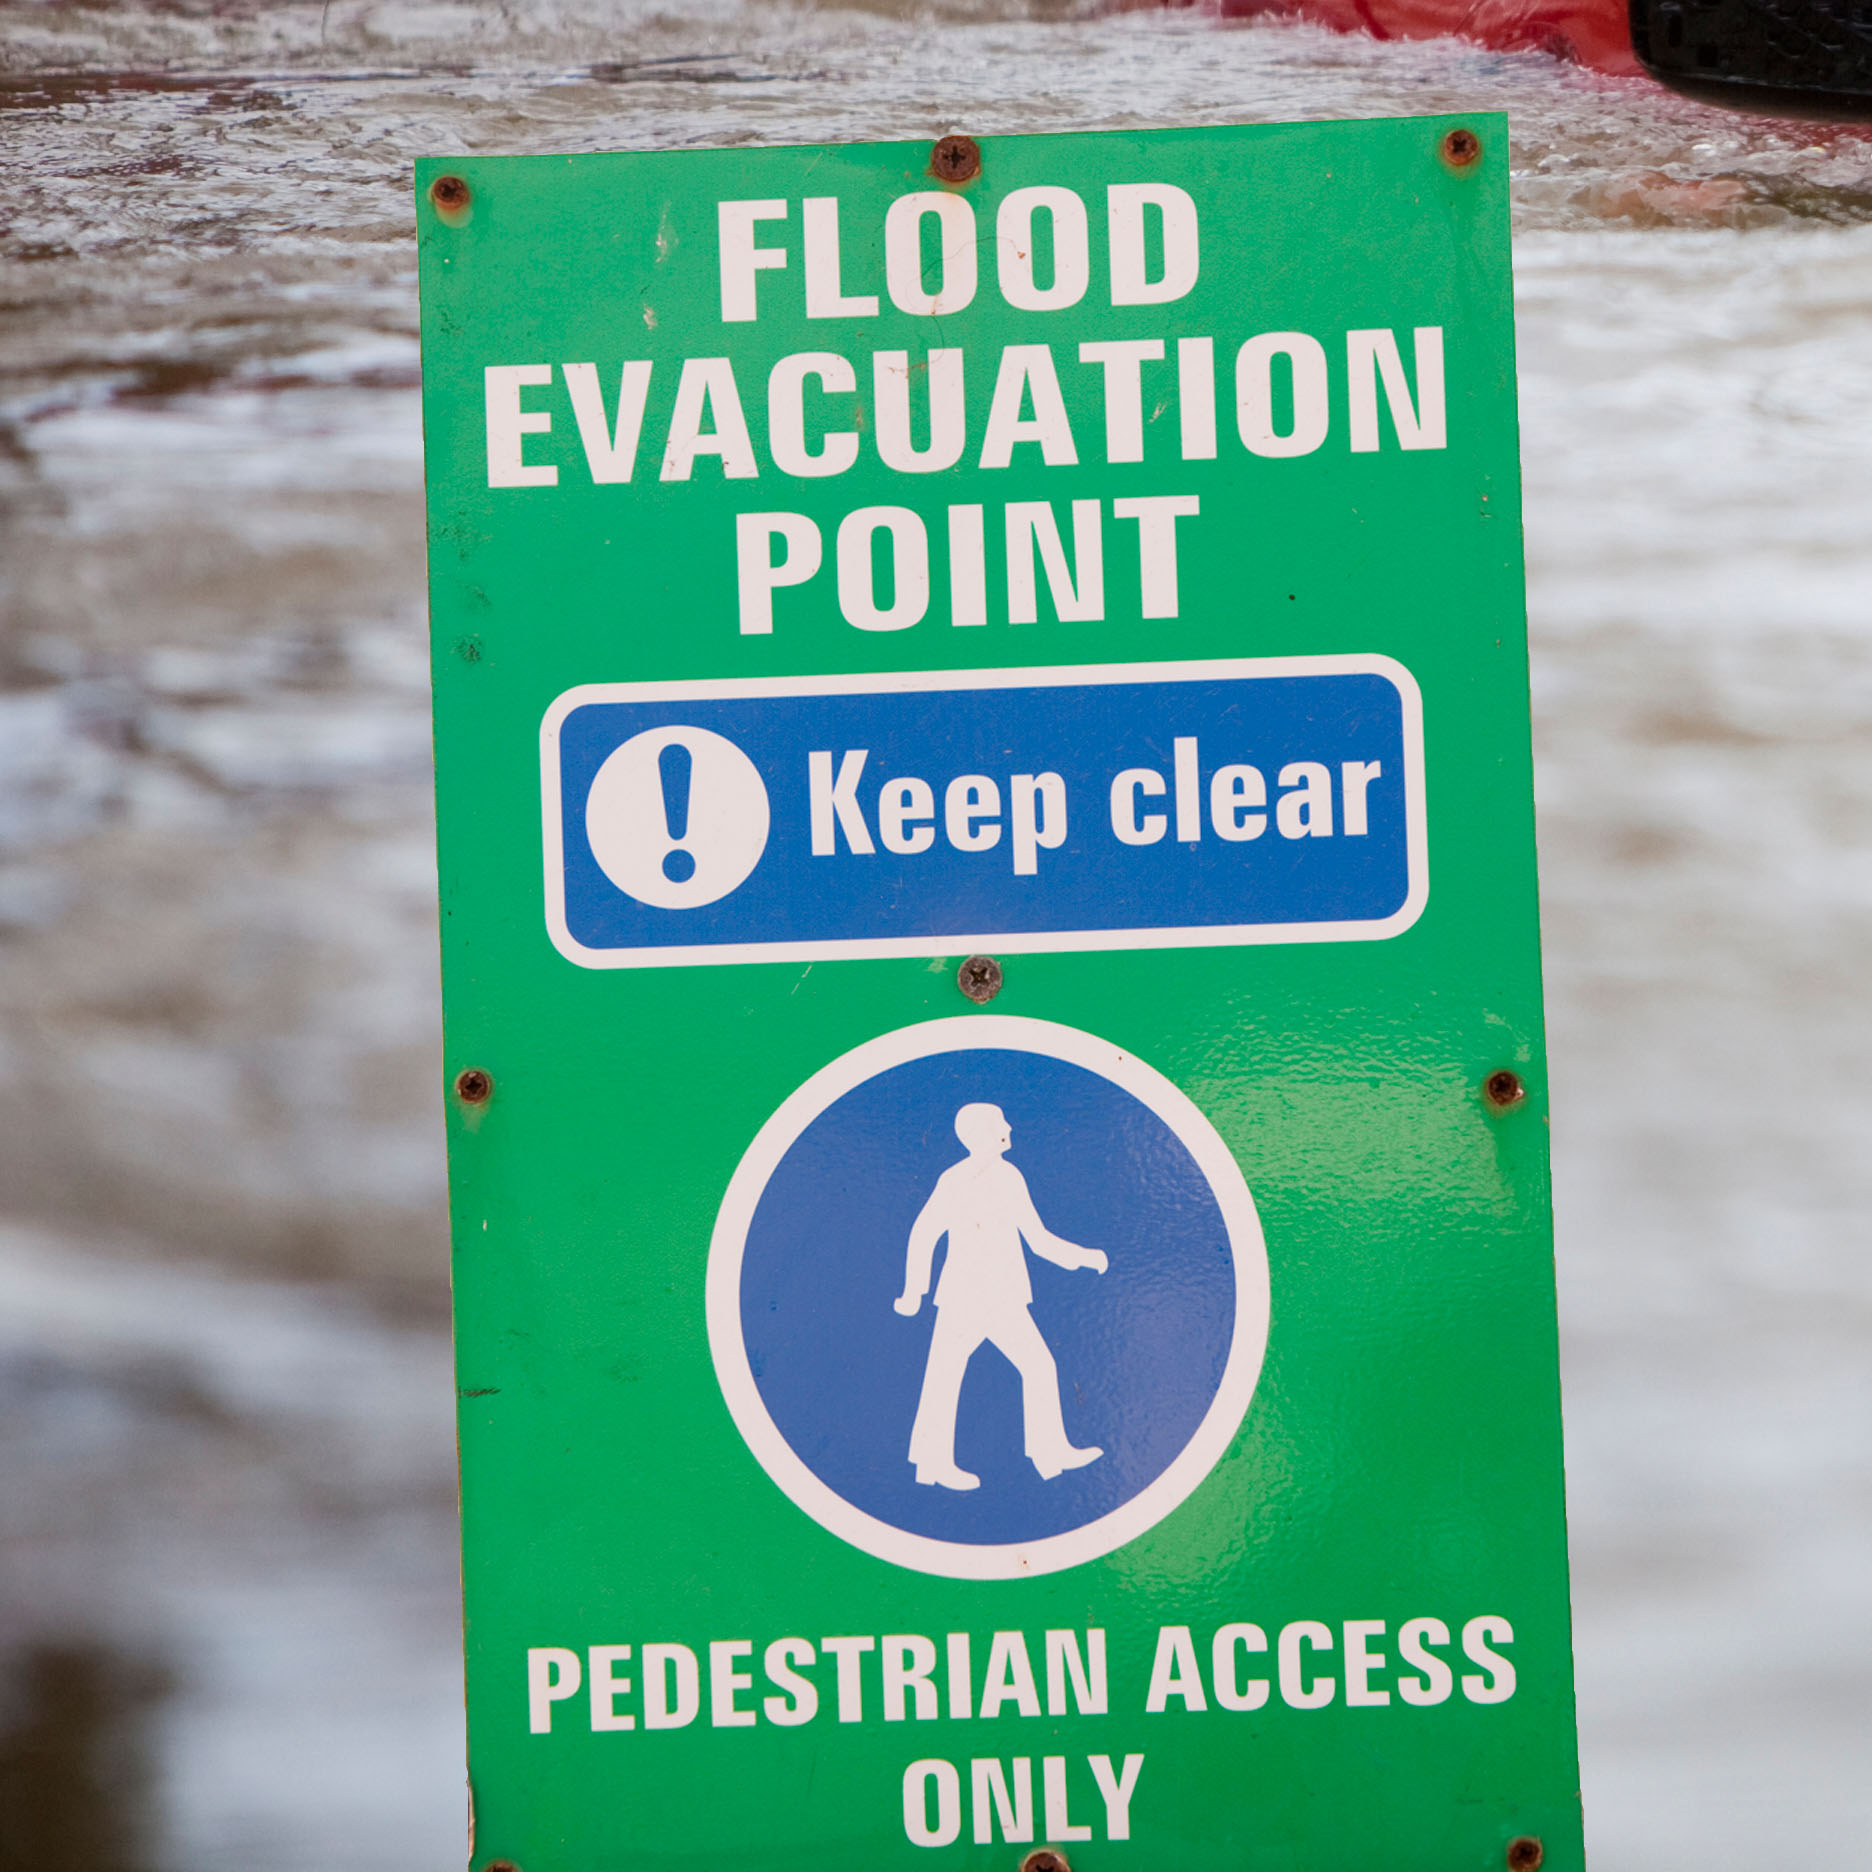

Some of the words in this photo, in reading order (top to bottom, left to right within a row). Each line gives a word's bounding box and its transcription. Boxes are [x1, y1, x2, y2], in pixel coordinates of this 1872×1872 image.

[718, 183, 1199, 322] FLOOD
[484, 326, 1447, 488] EVACUATION
[736, 495, 1200, 635] POINT
[808, 749, 1068, 876] Keep
[1110, 736, 1381, 846] clear
[527, 1628, 1108, 1734] PEDESTRIAN
[1145, 1615, 1517, 1713] ACCESS
[902, 1753, 1145, 1847] ONLY
